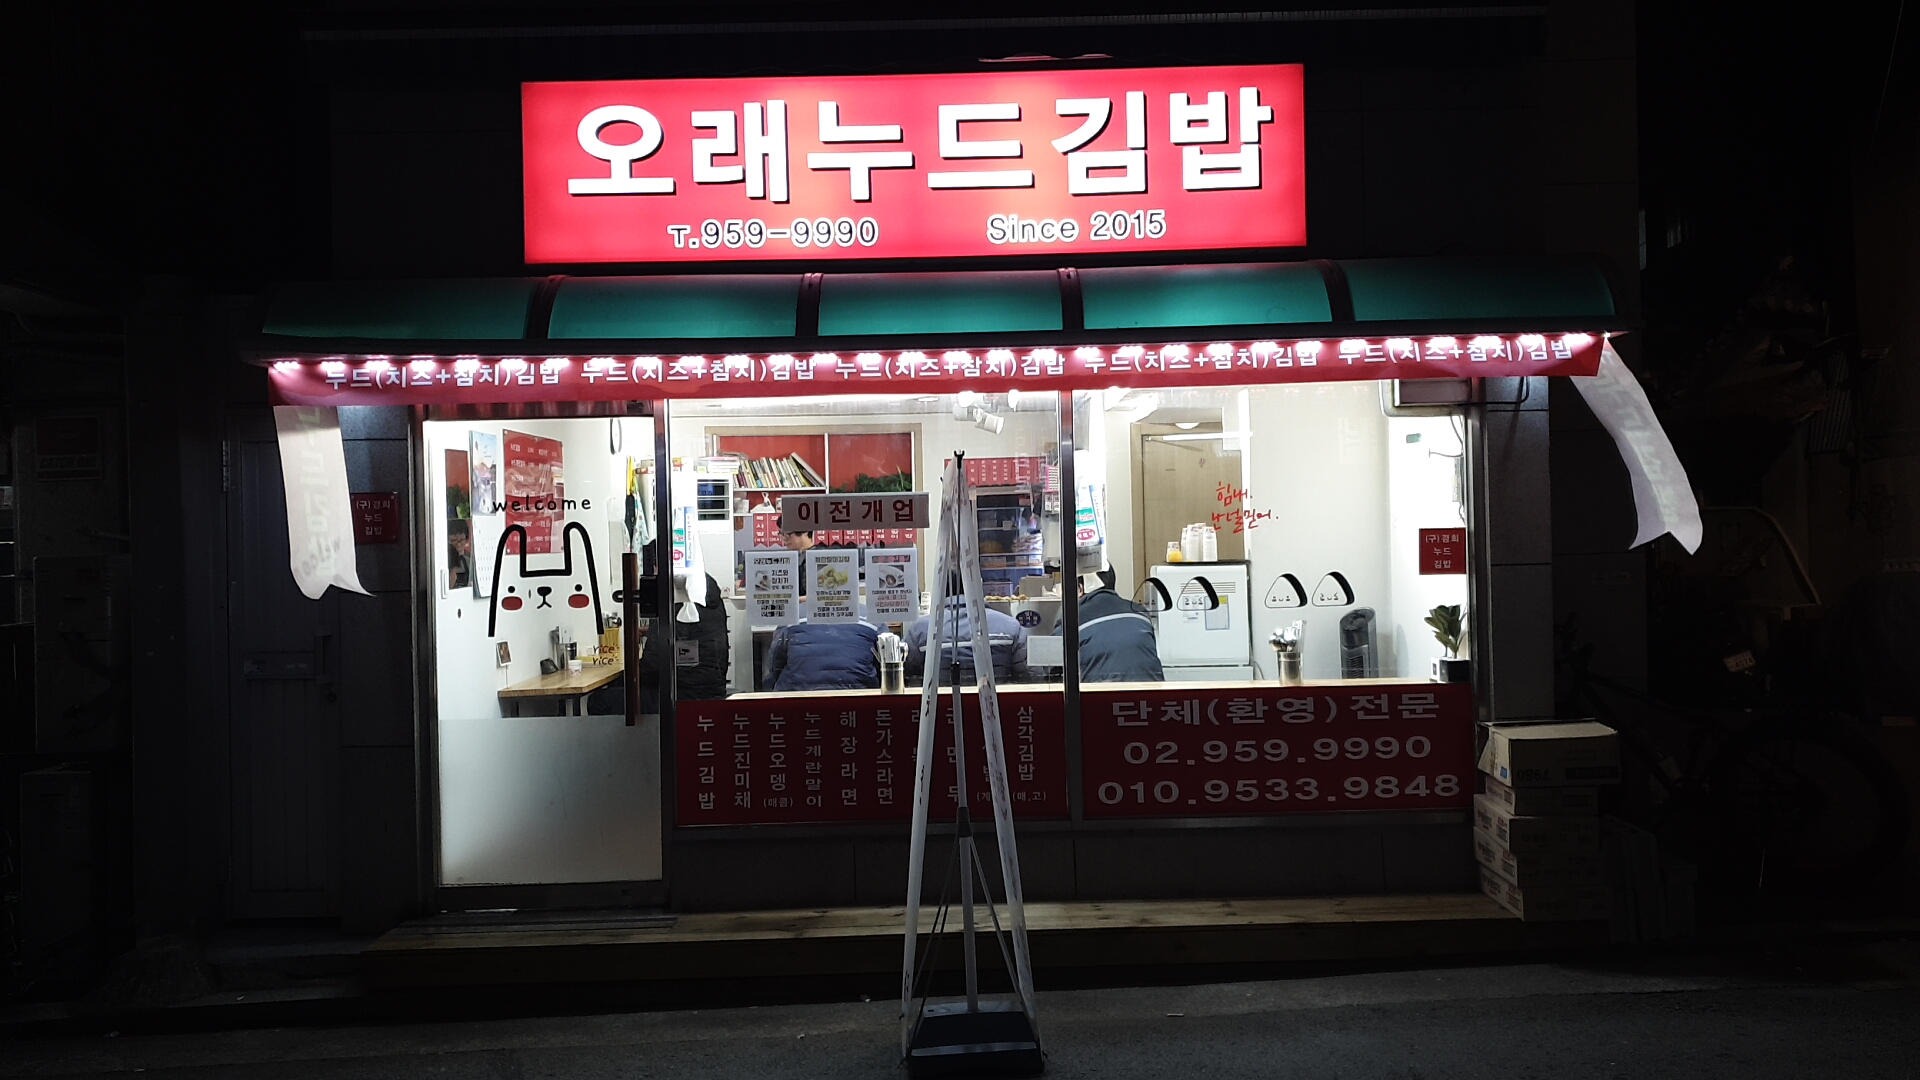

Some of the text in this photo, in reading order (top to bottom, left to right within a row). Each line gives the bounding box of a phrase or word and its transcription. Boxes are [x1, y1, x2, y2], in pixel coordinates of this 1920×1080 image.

[568, 87, 1273, 203] 오래누드김밥
[668, 217, 879, 249] T.959-9990
[987, 209, 1167, 244] Since 2015
[364, 513, 383, 522] 누드
[492, 495, 592, 512] welcome
[797, 499, 915, 524] 이전개업
[365, 526, 383, 536] 김밥
[1425, 534, 1440, 543] (구)
[1433, 547, 1452, 556] 누드
[1434, 560, 1452, 569] 김밥
[593, 645, 614, 654] rice
[593, 656, 614, 665] rice
[769, 713, 786, 791] 누드오뎅
[840, 711, 857, 806] 해장라면
[876, 709, 893, 805] 돈가스라면
[1016, 706, 1035, 781] 삼각김밥
[1123, 735, 1432, 766] 02.959.9990
[697, 715, 715, 810] 누드김밥
[733, 713, 751, 808] 누드진미채
[804, 712, 822, 808] 누드계란말이
[1098, 774, 1460, 806] 010.9533.9848
